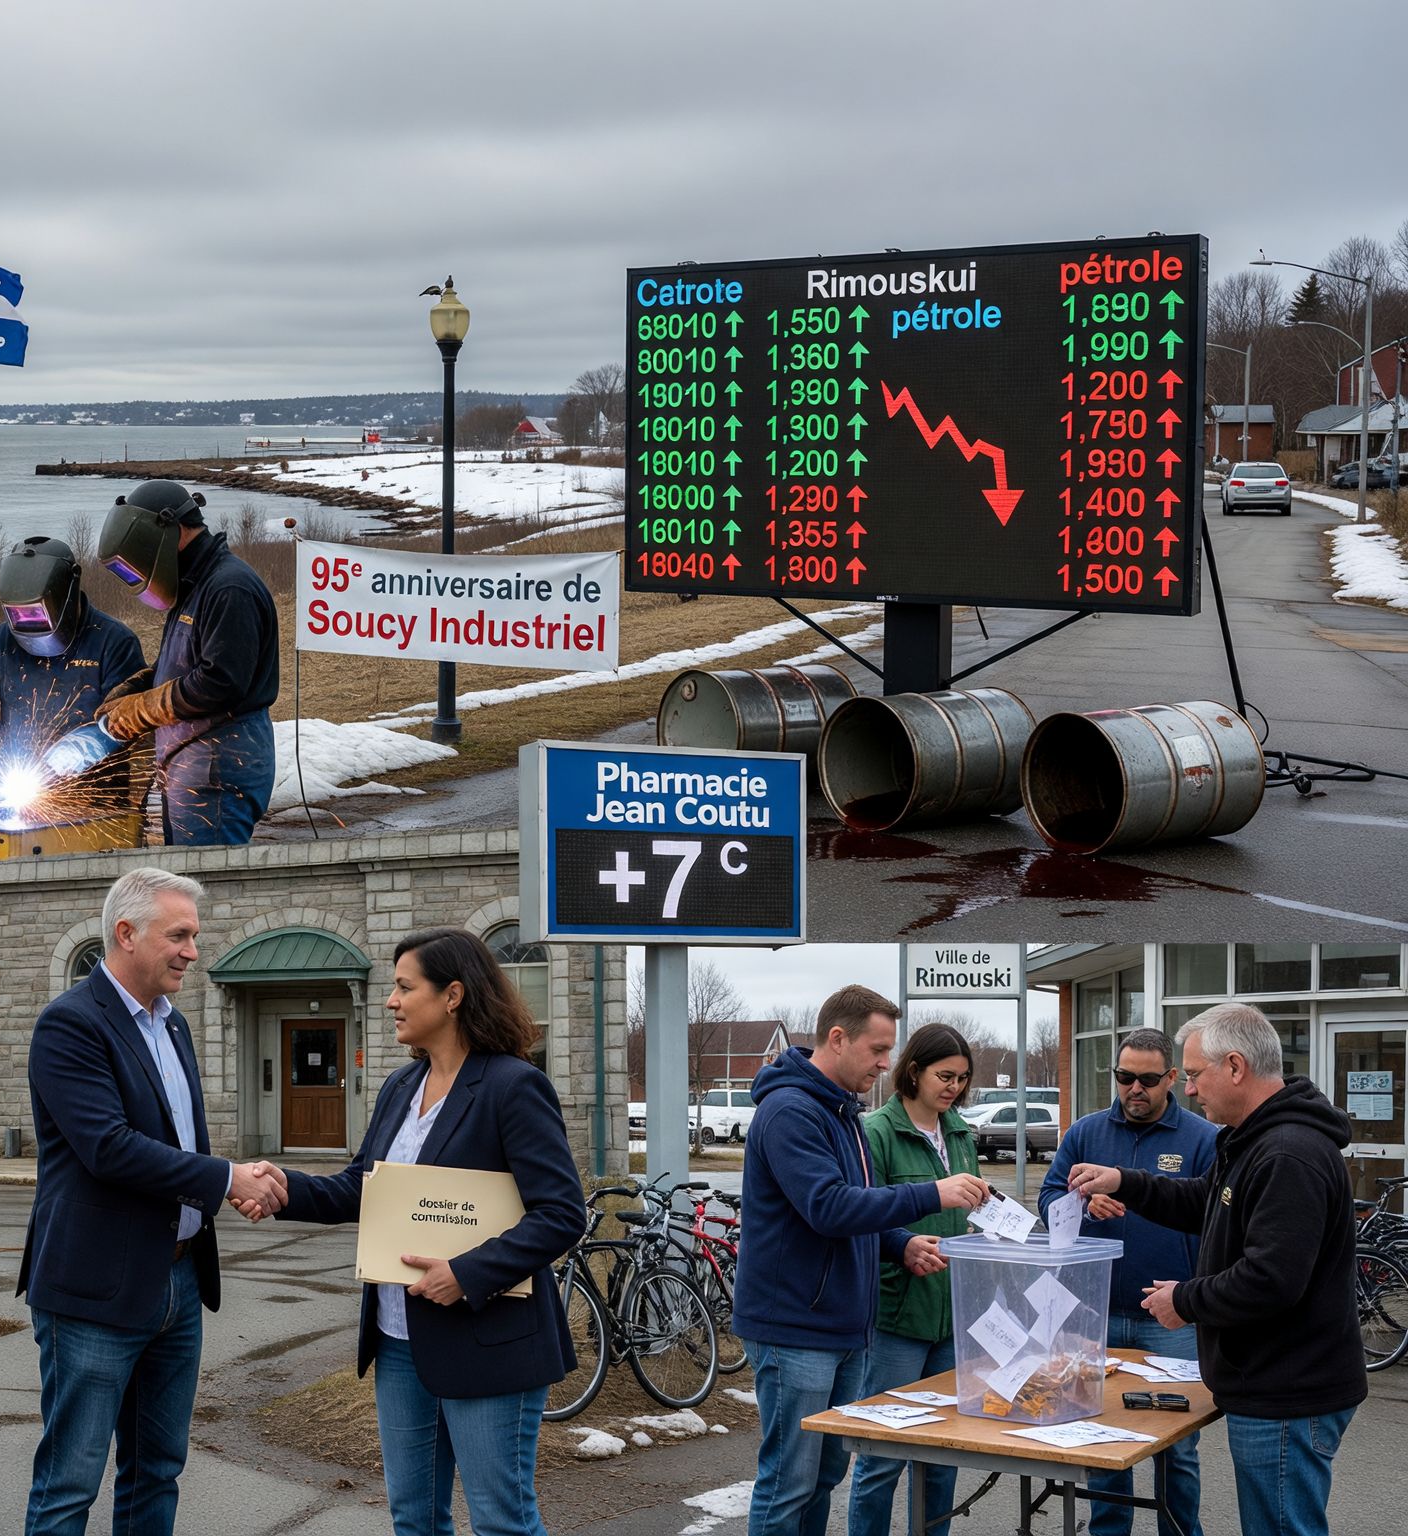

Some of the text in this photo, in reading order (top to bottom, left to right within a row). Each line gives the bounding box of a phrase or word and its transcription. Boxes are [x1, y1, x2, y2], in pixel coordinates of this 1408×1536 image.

[807, 262, 977, 299] Rimouskui
[1061, 250, 1183, 293] pétrole
[767, 306, 840, 338] 1,550
[892, 299, 1002, 338] pétrole
[767, 342, 840, 374] 1,360
[1062, 330, 1149, 366] 1,990
[1061, 369, 1148, 405] 1,200
[637, 450, 715, 476] 18010
[765, 449, 839, 480] 1,200
[1058, 487, 1146, 521] 1,400
[638, 518, 714, 545] 16010
[371, 568, 552, 602] anniversaire
[563, 573, 602, 604] de
[1057, 564, 1144, 598] 1,500
[307, 599, 606, 652] Soucy Industriel
[597, 761, 768, 798] Pharmacie
[586, 793, 770, 828] Jean Coutu
[598, 839, 749, 919] +7 C
[935, 950, 991, 965] Ville de
[915, 967, 1011, 988] Rimouski
[419, 1197, 476, 1212] dossier de
